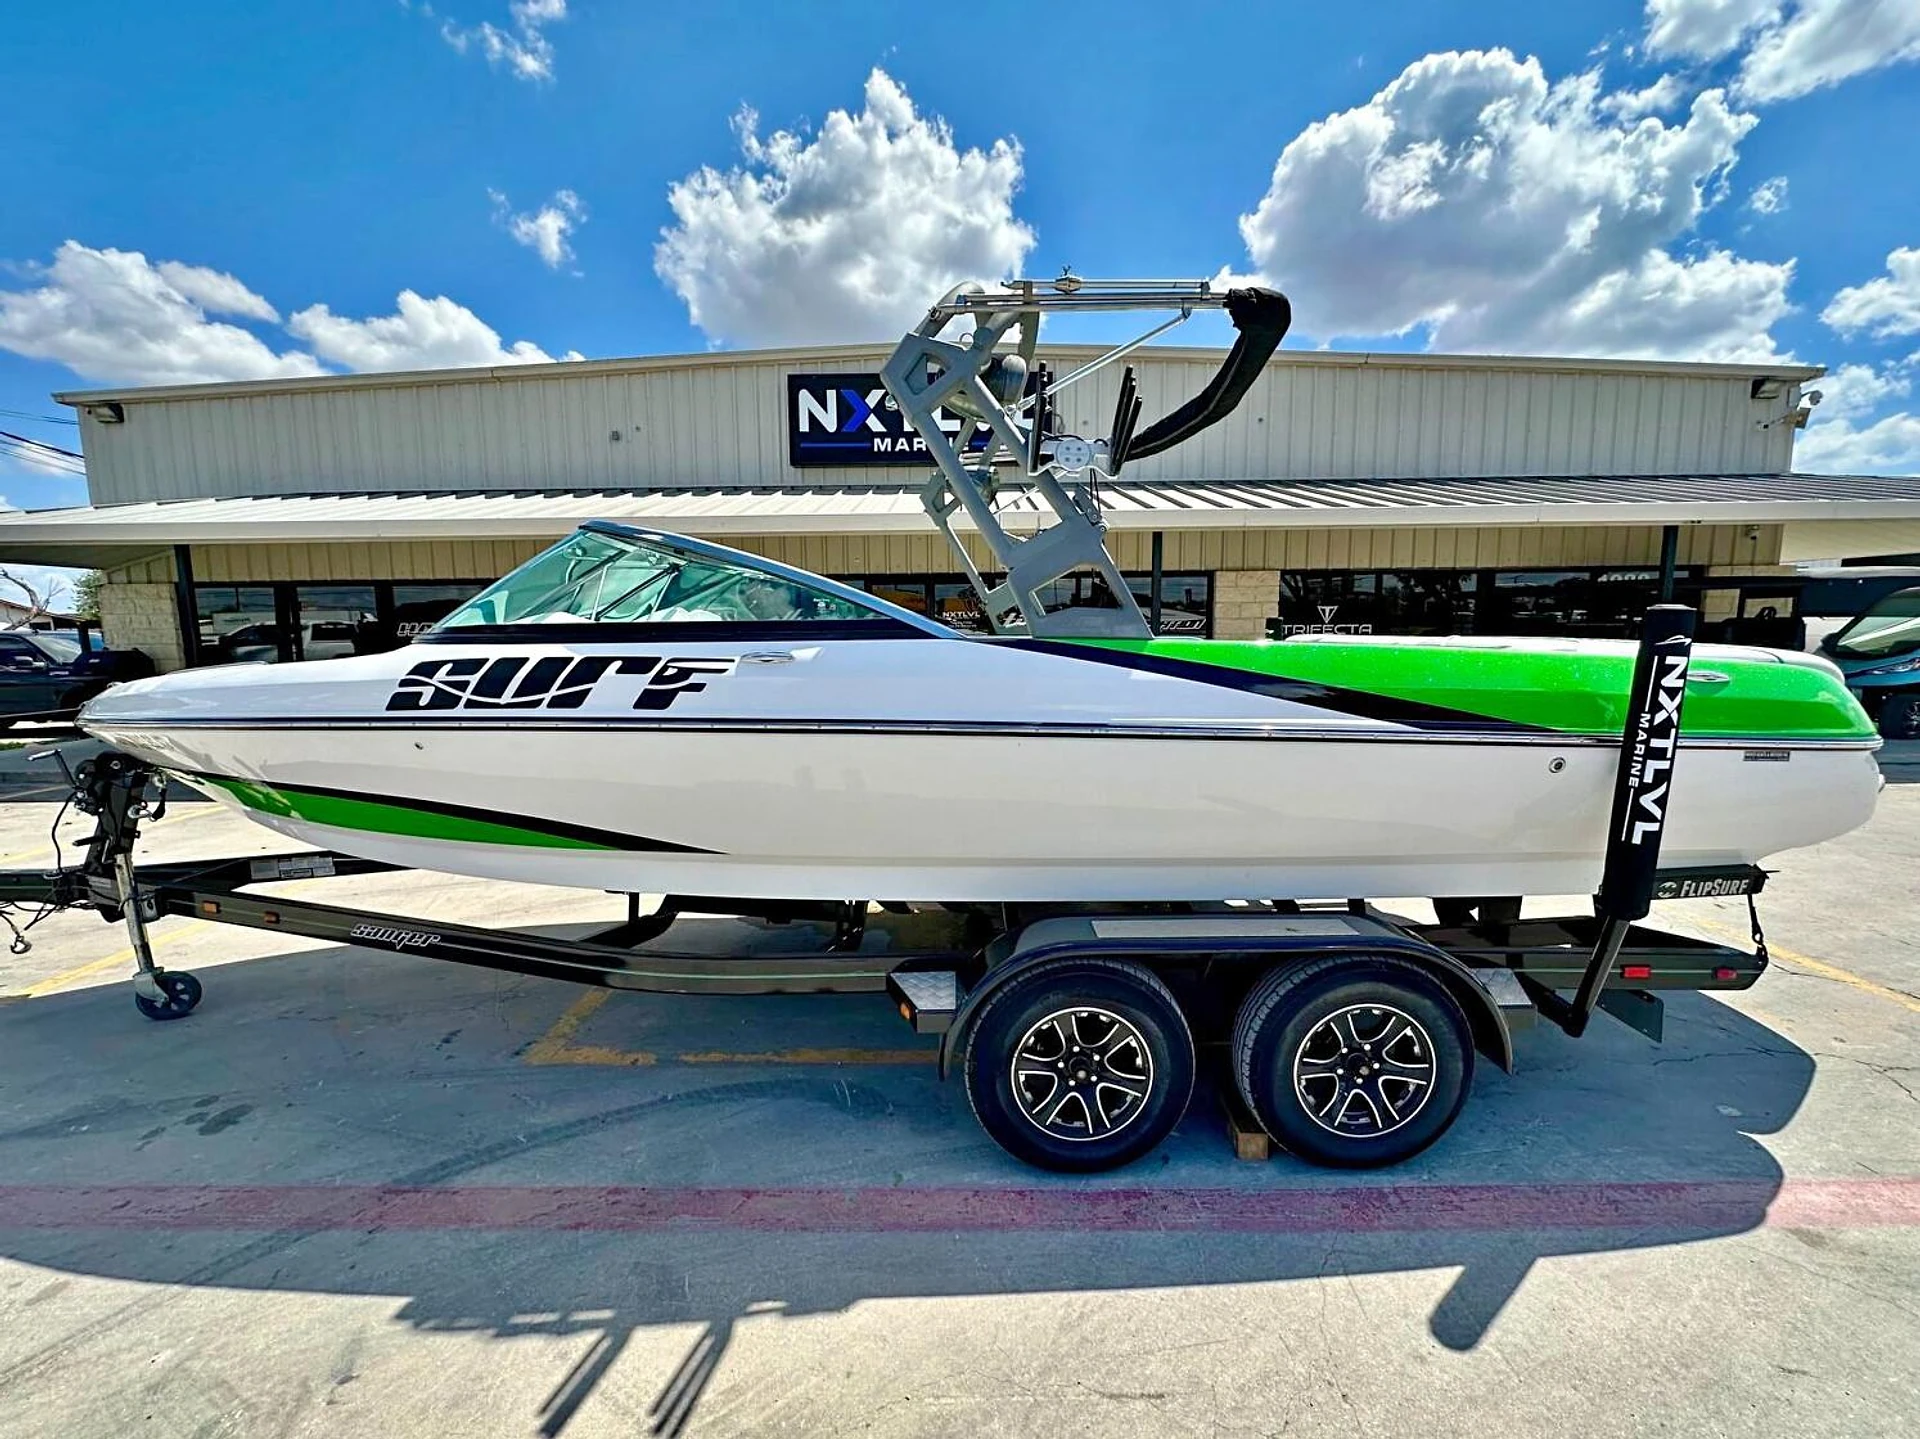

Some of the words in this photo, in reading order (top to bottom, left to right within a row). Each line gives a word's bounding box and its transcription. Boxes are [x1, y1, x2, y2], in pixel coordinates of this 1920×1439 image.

[942, 610, 981, 619] NXTLVL
[1282, 624, 1373, 635] TRIFECTA
[1628, 712, 1651, 788] MARINE
[1631, 655, 1689, 845] NXTLVL
